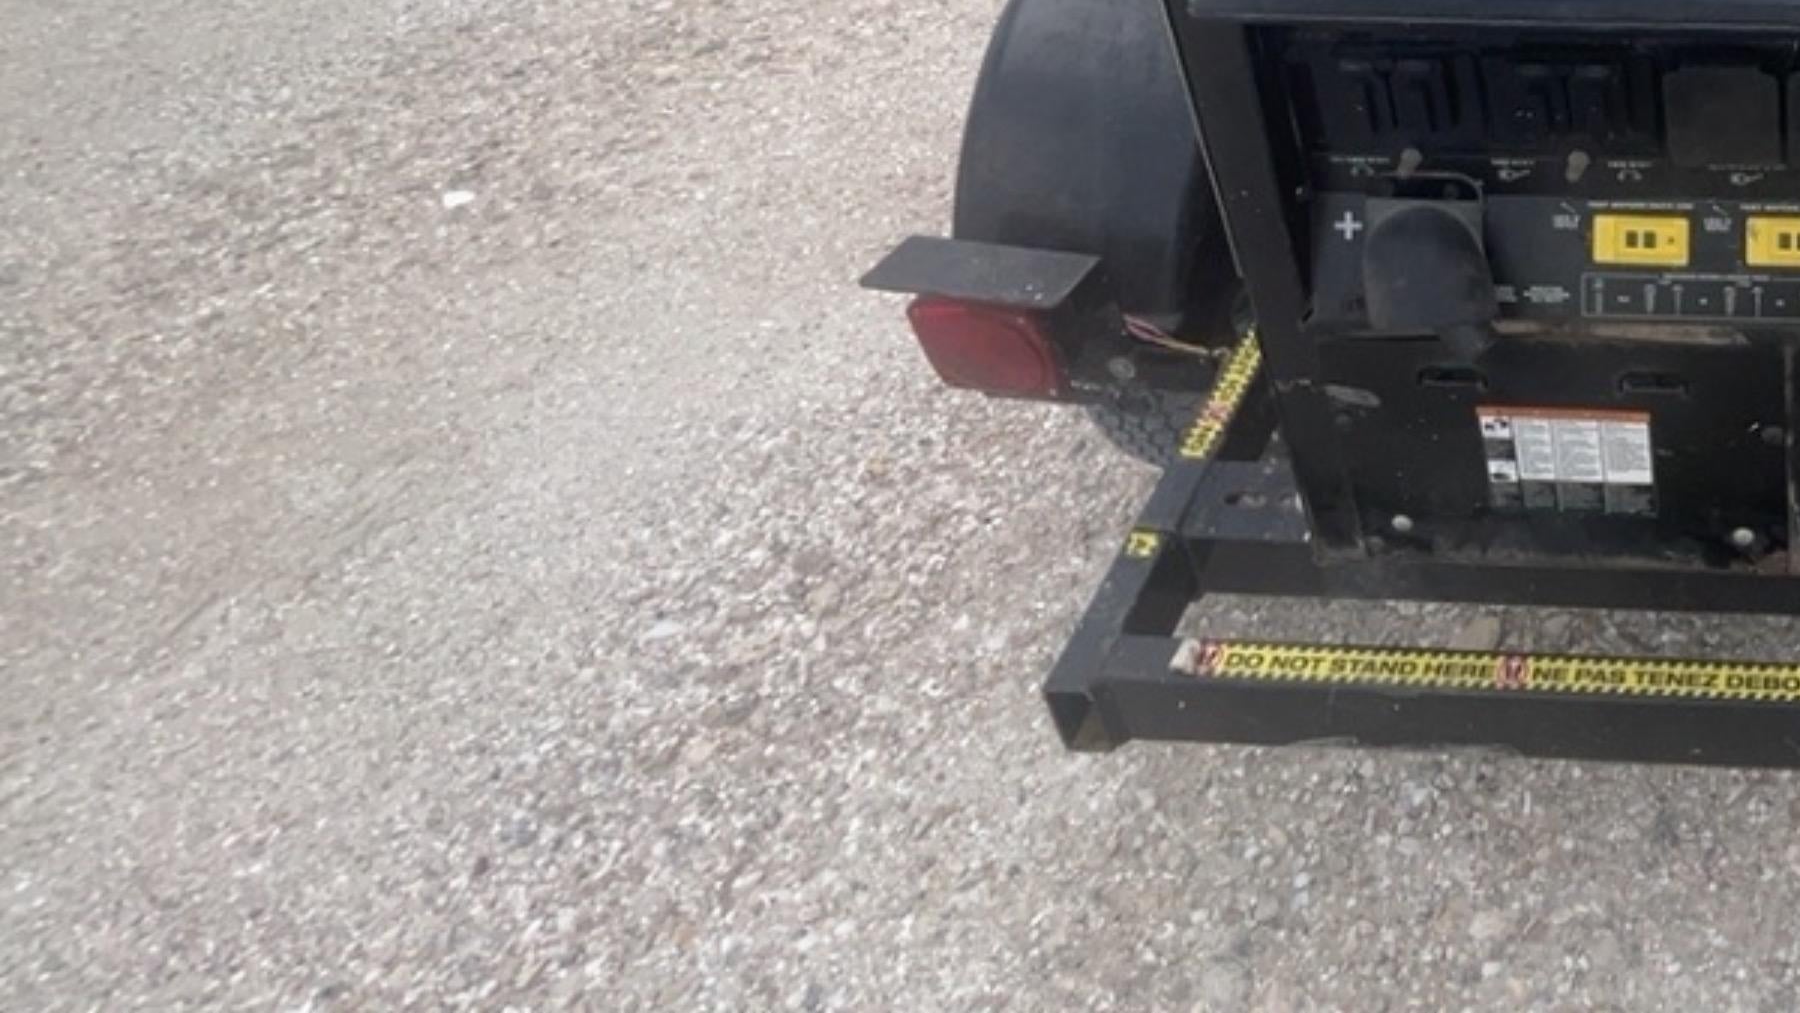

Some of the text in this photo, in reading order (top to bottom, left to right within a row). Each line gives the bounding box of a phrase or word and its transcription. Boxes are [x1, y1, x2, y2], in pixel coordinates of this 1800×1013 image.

[1225, 652, 1264, 669] DO
[1268, 655, 1328, 673] NOT
[1329, 659, 1417, 675] STAND
[1421, 662, 1493, 679] HERE
[1532, 668, 1567, 682] NE
[1573, 669, 1625, 685] PAS
[1635, 670, 1718, 688] TENEZ
